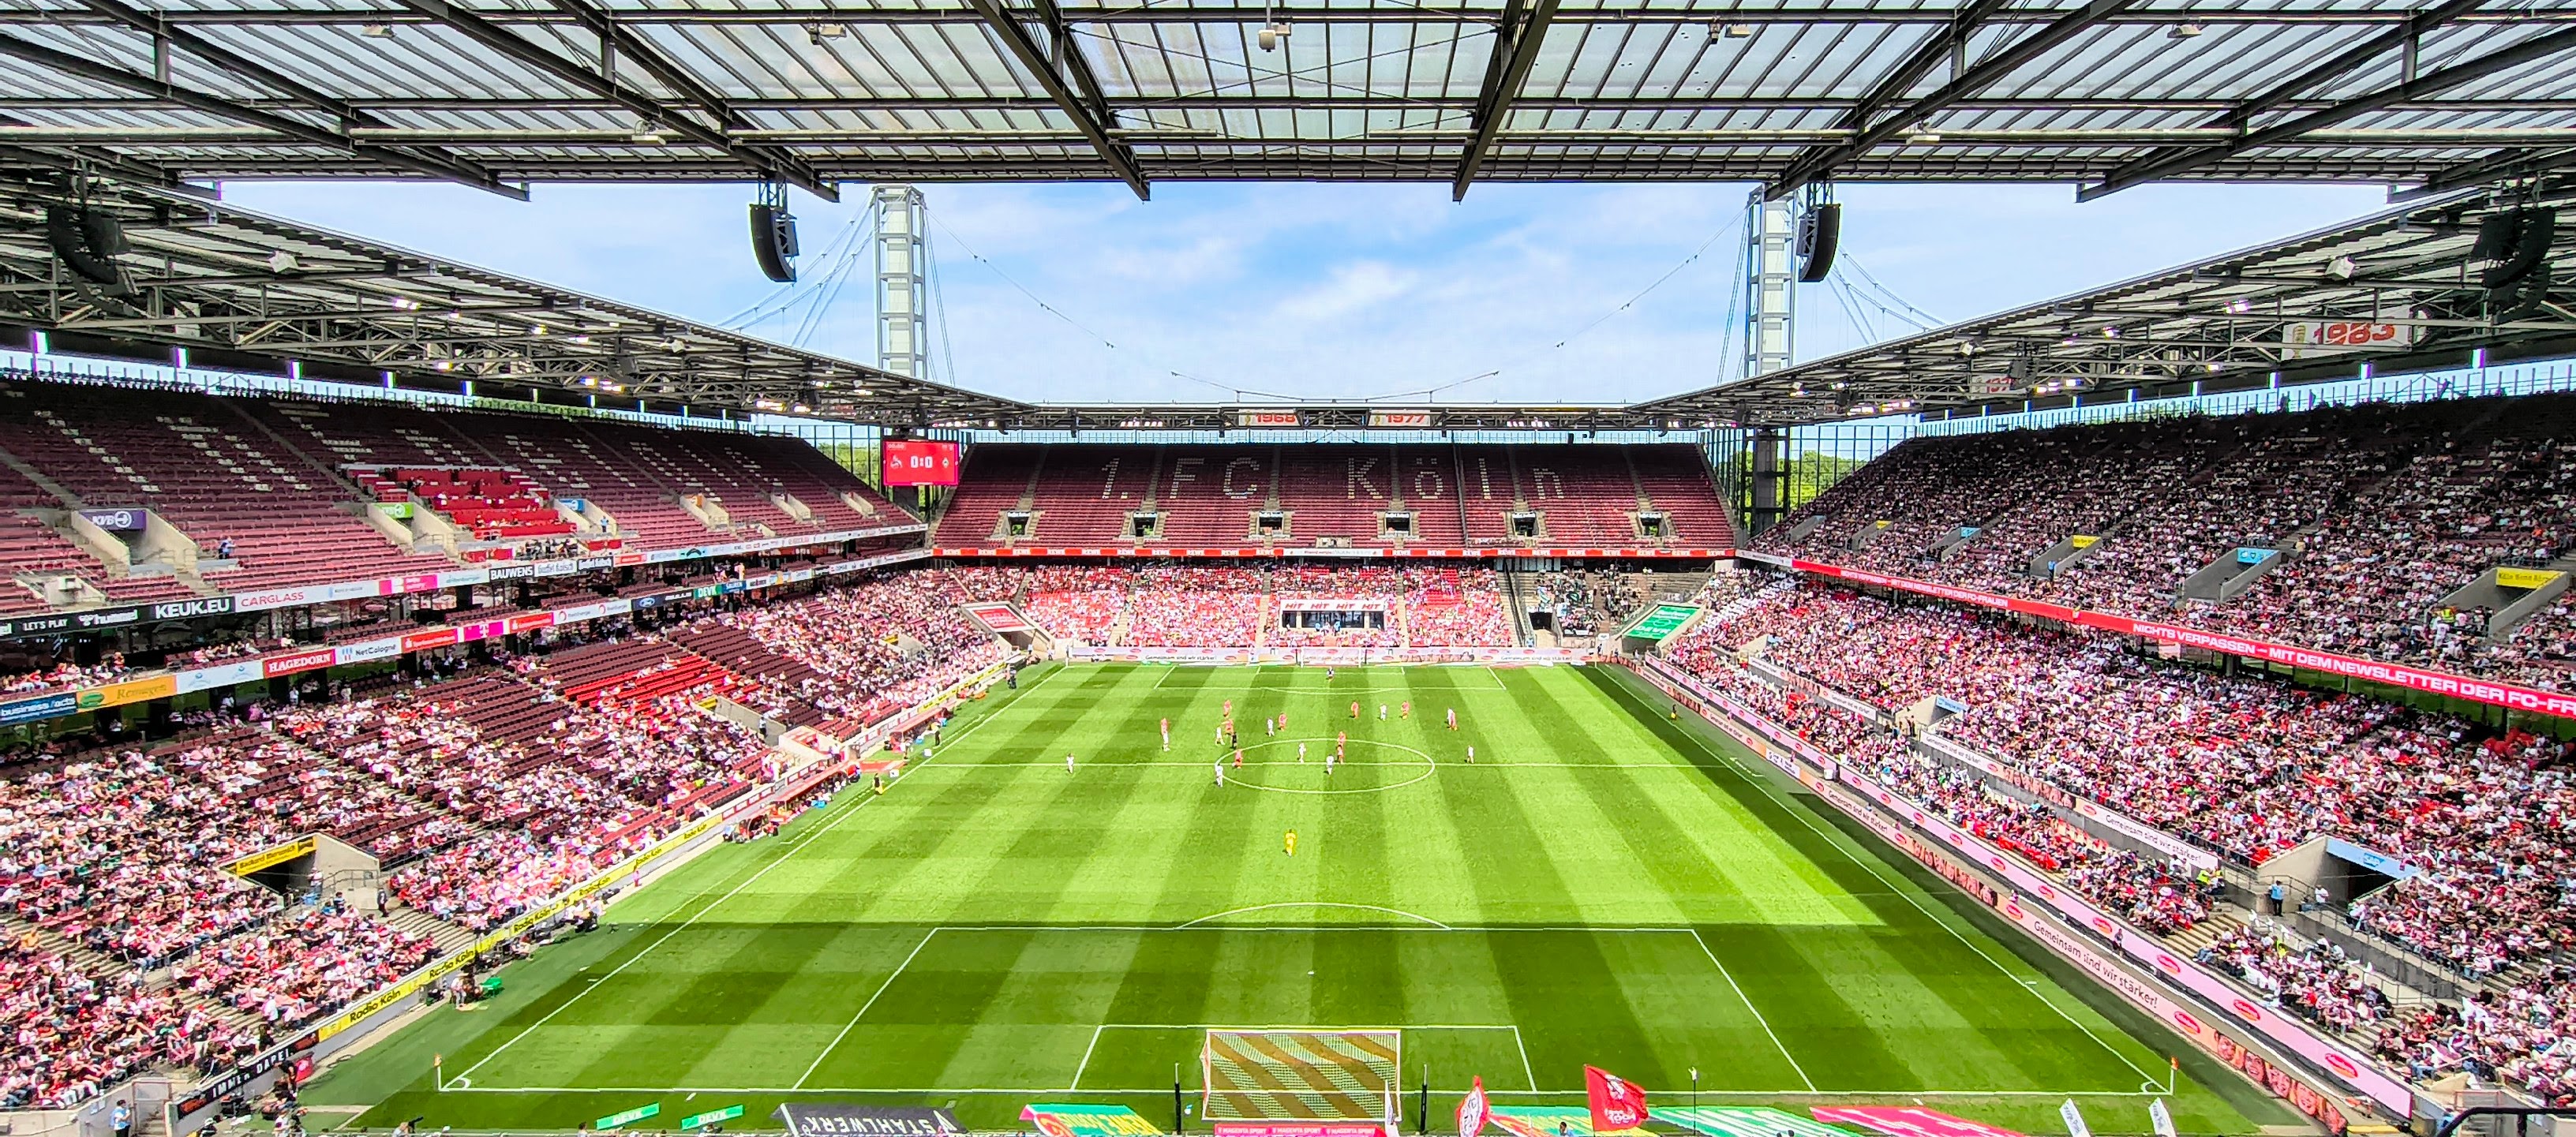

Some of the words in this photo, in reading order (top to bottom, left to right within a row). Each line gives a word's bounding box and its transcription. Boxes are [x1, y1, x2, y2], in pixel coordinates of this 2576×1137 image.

[2313, 322, 2395, 345] 1983
[1255, 413, 1296, 423] 1968
[1386, 413, 1426, 423] 1977
[910, 455, 933, 469] 0:0
[490, 567, 534, 580] BAUWENS
[155, 597, 230, 619] KEUK.EU
[241, 592, 305, 607] CARGLASS
[24, 621, 46, 631] LET'S
[49, 619, 69, 628] PLAY
[95, 609, 138, 625] hummel
[355, 644, 396, 656] NetCologne
[268, 653, 331, 673] HAGEDORN
[2132, 623, 2176, 639] NICHTS
[2176, 630, 2256, 654] VERPASSEN
[2268, 647, 2295, 662] MIT
[2296, 653, 2332, 669] DEM
[2334, 660, 2460, 694] NEWSLETTER
[2460, 683, 2505, 702] DER
[2106, 814, 2144, 837] Gemeinsam
[2144, 832, 2159, 844] sind
[2159, 839, 2172, 848] wir
[2172, 845, 2201, 862] stärker!
[513, 917, 534, 933] Radio
[534, 908, 552, 921] Köln
[429, 960, 454, 979] Radio
[455, 949, 475, 964] Köln
[2034, 920, 2081, 959] Gemeinsam
[2082, 952, 2101, 971] sind
[2102, 965, 2118, 982] wir
[2119, 978, 2159, 1009] stärker!
[350, 1002, 378, 1023] Radio
[380, 989, 401, 1005] Köln
[803, 1116, 938, 1135] STAHLWERK
